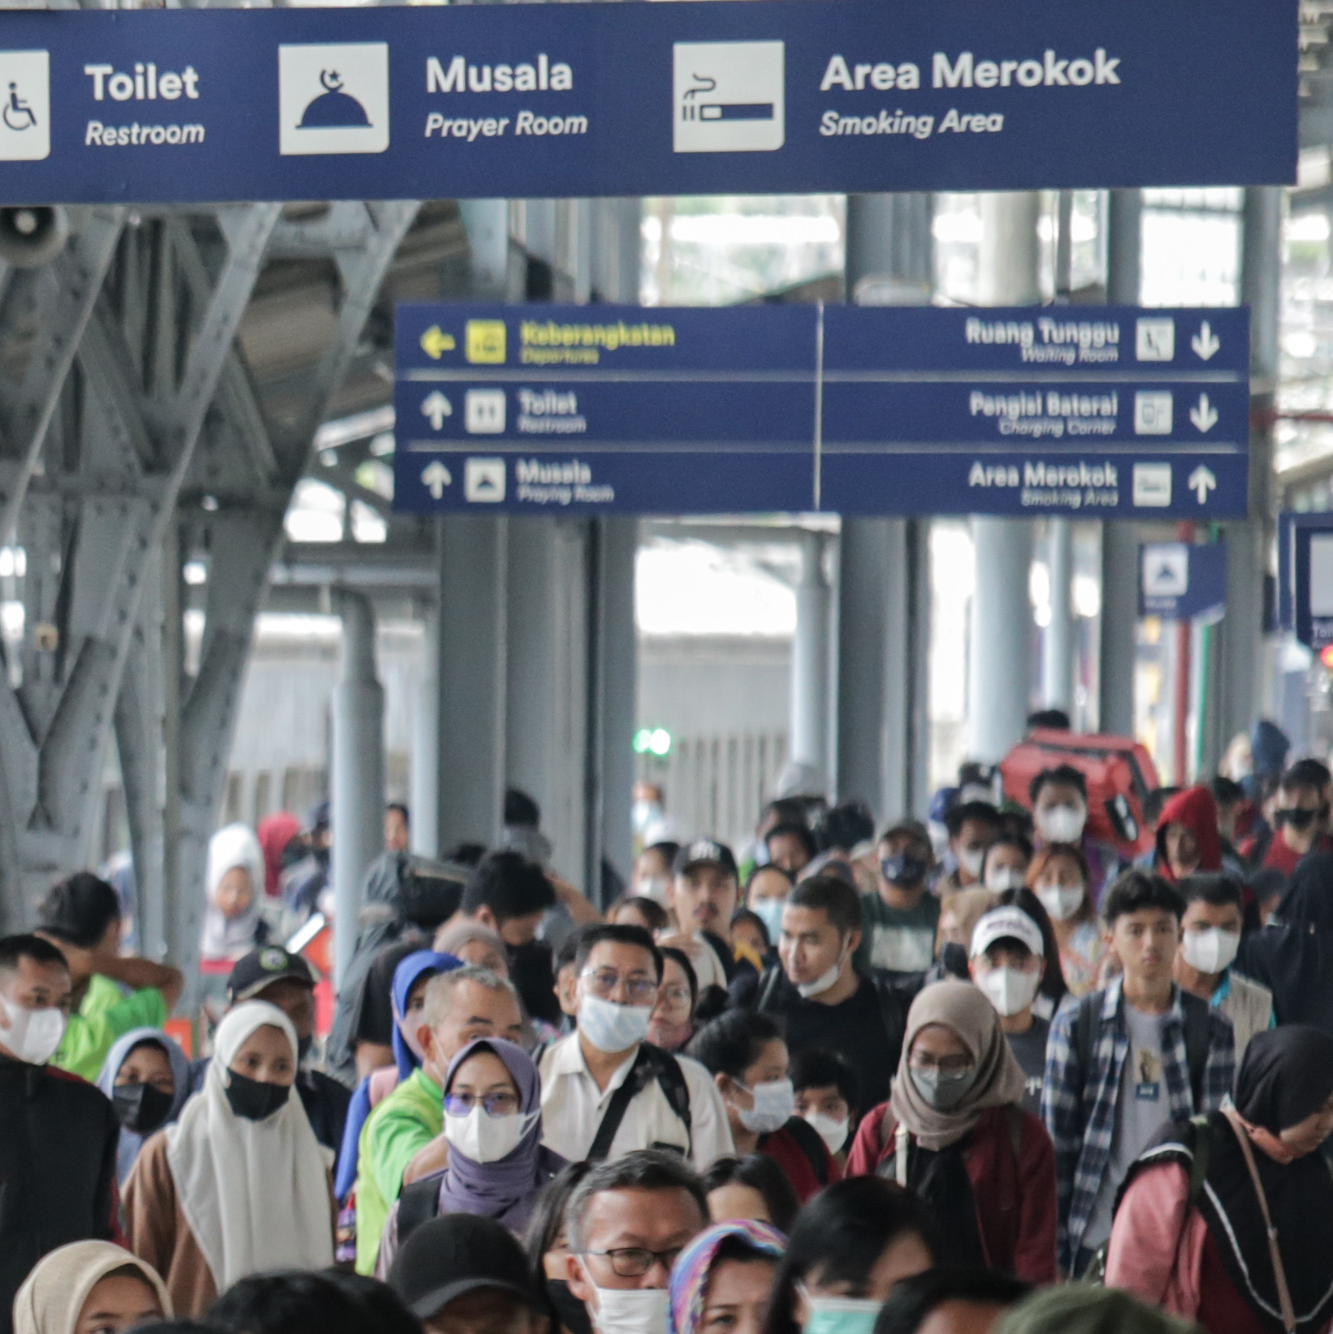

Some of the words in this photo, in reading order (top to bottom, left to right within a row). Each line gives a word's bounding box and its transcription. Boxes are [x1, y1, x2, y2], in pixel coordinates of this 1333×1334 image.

[84, 63, 199, 101] Toilet
[425, 54, 574, 93] Musala
[819, 55, 920, 91] Area
[932, 48, 1121, 88] Merokok
[84, 120, 206, 147] Restroom
[424, 112, 511, 143] Prayer
[515, 111, 589, 138] Room
[818, 108, 935, 140] Smoking
[938, 108, 1005, 134] Area
[520, 321, 676, 350] Keberangkatan
[965, 318, 1035, 346] Ruang
[1038, 318, 1120, 346] Tunggu
[1021, 348, 1076, 365] Waiting
[1079, 349, 1119, 363] Room
[518, 390, 577, 415] Toilet
[970, 391, 1042, 419] Pengisi
[1047, 390, 1119, 417] Baterai
[999, 419, 1064, 437] Charging
[1068, 420, 1116, 435] Corner
[516, 459, 591, 484] Musala
[968, 462, 1020, 488] Area
[1023, 461, 1119, 488] Merokok
